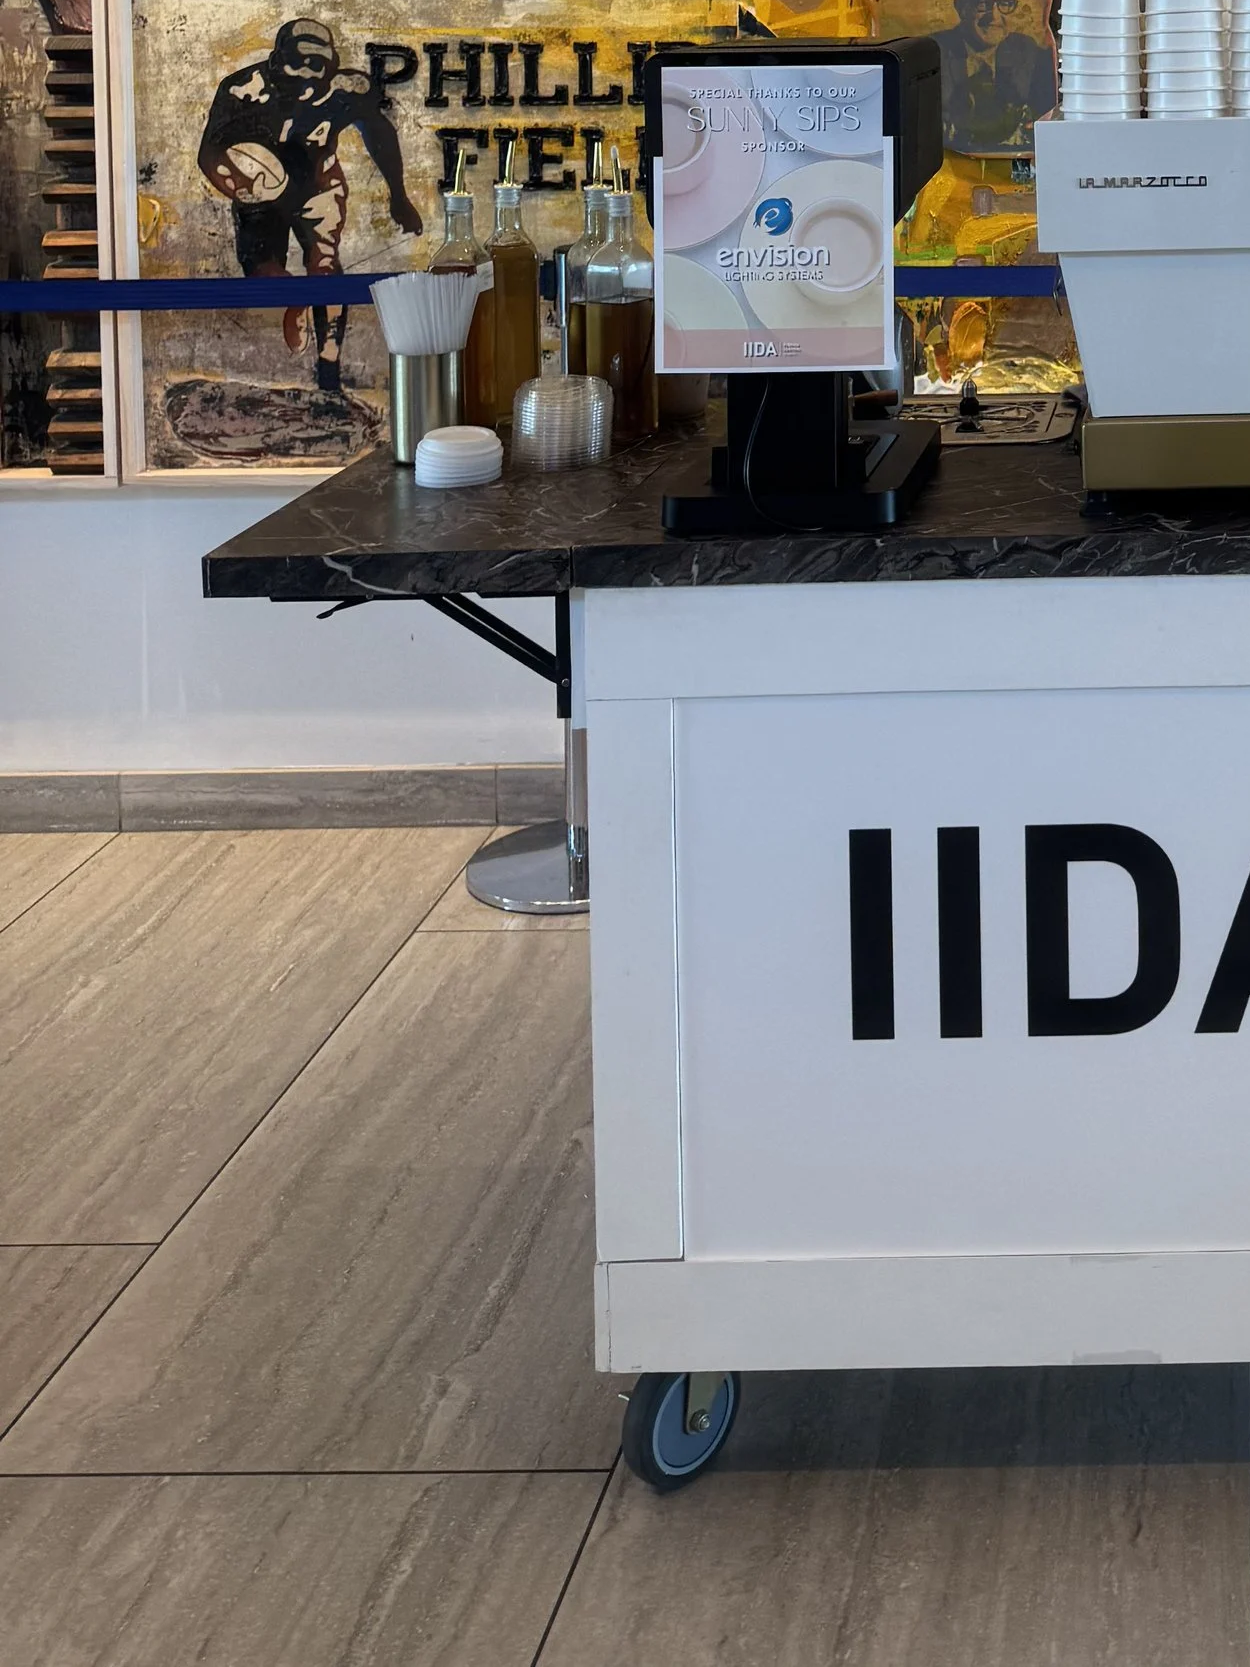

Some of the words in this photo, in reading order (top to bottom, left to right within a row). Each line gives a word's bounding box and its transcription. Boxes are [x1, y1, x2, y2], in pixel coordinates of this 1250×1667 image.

[365, 42, 697, 108] PHILLI
[689, 88, 743, 99] SPECIAL
[748, 87, 801, 99] THANKS
[806, 87, 823, 98] TO
[828, 87, 857, 98] OUR
[686, 106, 787, 133] SUNNY
[796, 104, 862, 132] SIPS
[741, 141, 806, 153] SPONSOR
[716, 245, 831, 268] envision
[743, 341, 779, 358] IIDA
